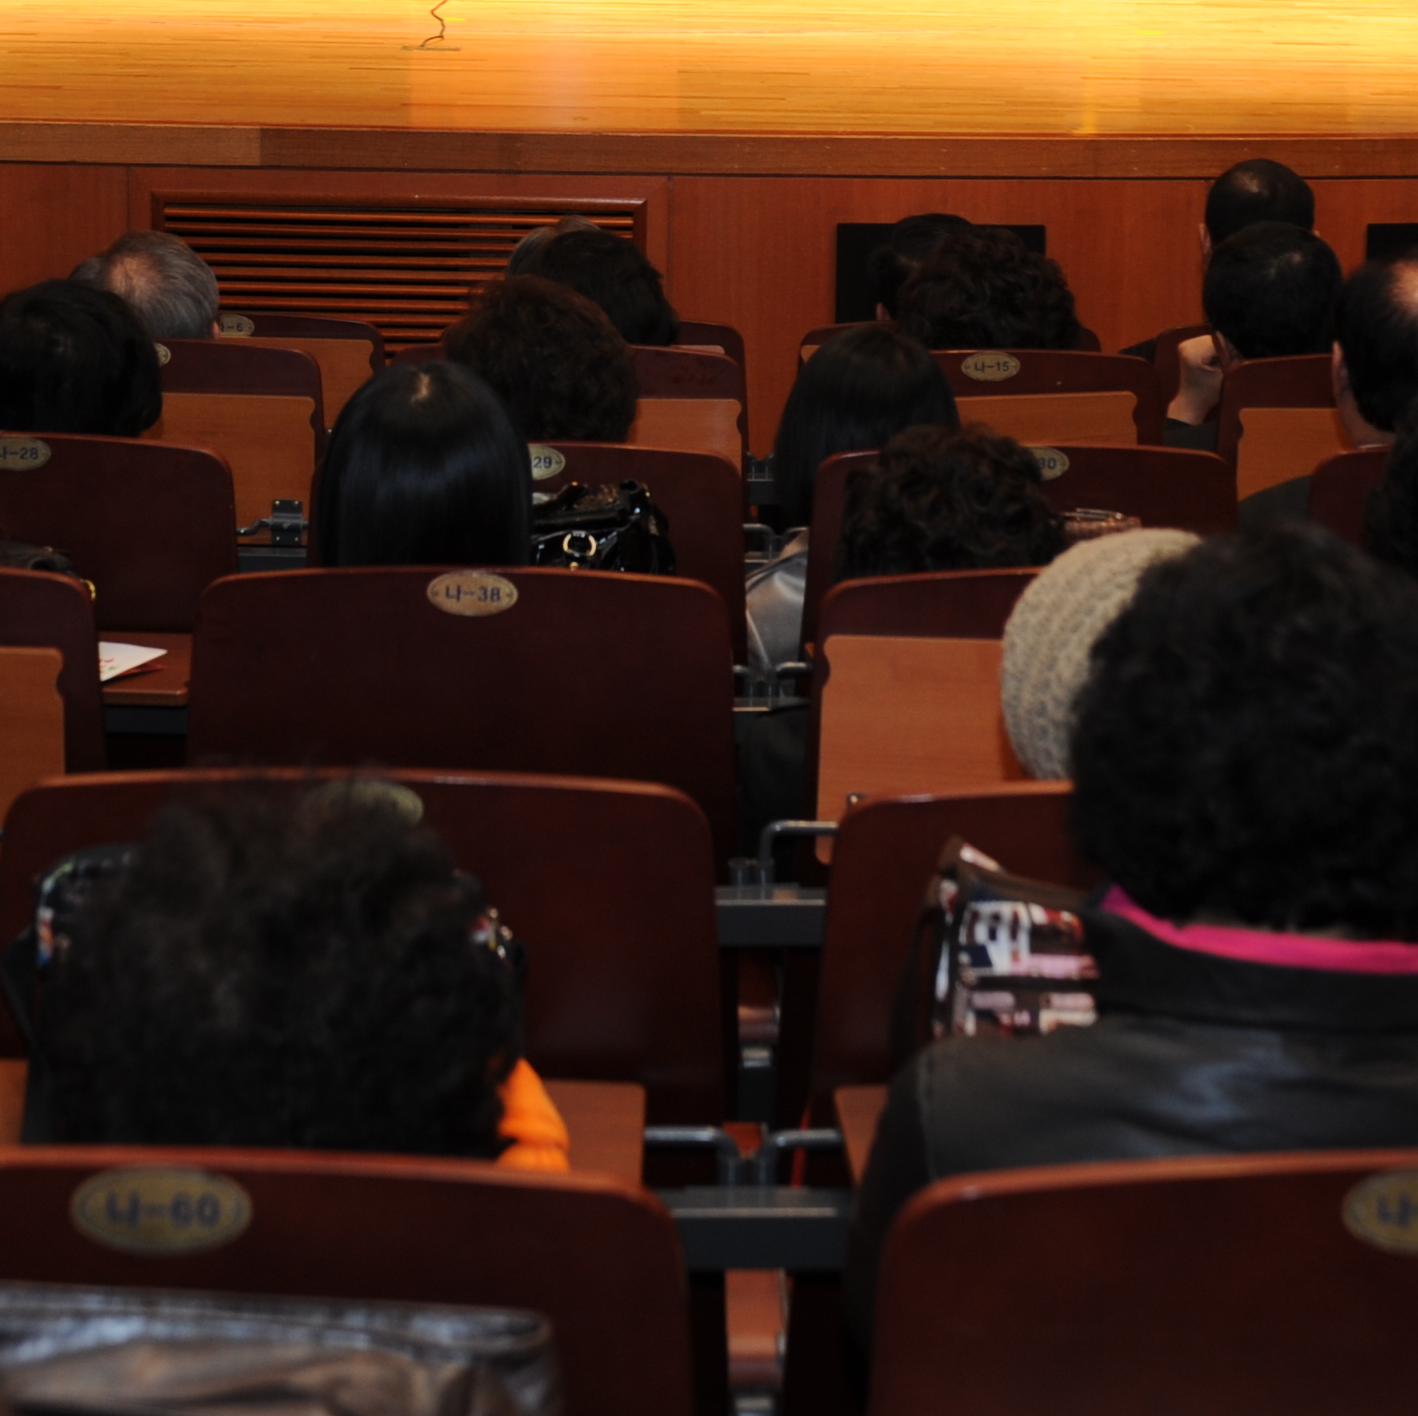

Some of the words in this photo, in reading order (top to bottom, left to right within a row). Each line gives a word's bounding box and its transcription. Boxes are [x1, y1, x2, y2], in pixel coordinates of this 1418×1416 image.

[974, 360, 1010, 373] 나-15
[533, 455, 553, 470] 29
[444, 584, 502, 602] 나-38
[104, 1190, 222, 1226] 나-60
